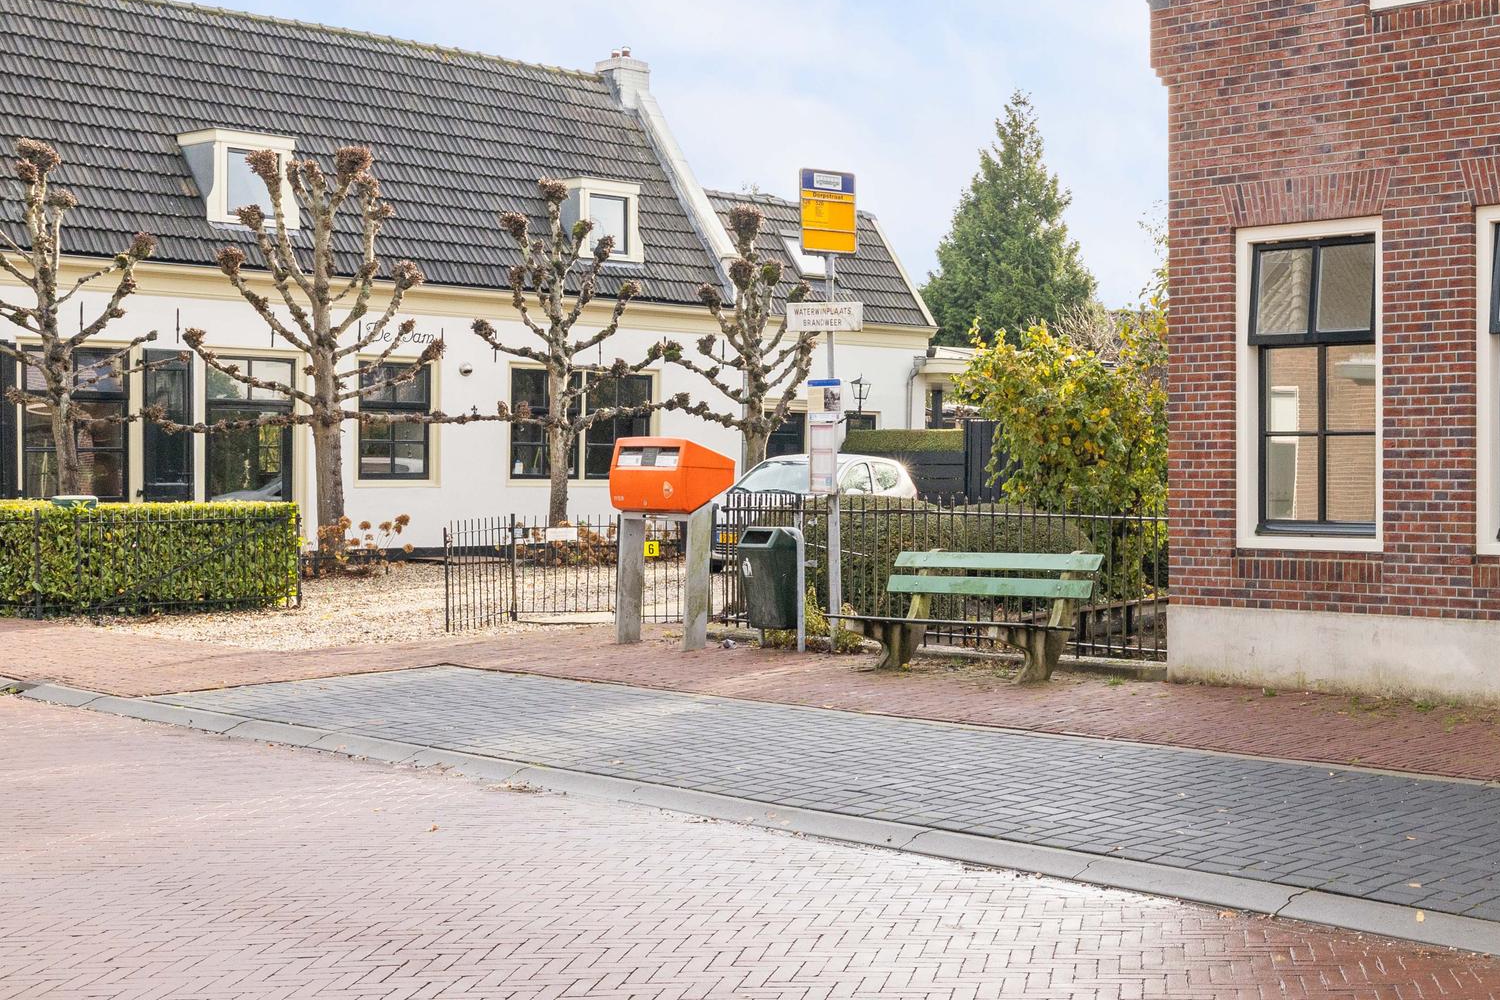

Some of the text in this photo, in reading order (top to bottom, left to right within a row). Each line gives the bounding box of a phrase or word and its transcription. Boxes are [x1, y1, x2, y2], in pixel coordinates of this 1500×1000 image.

[812, 191, 844, 201] Dorpstraat
[803, 318, 841, 327] BRANDWEER
[648, 543, 655, 555] 6
